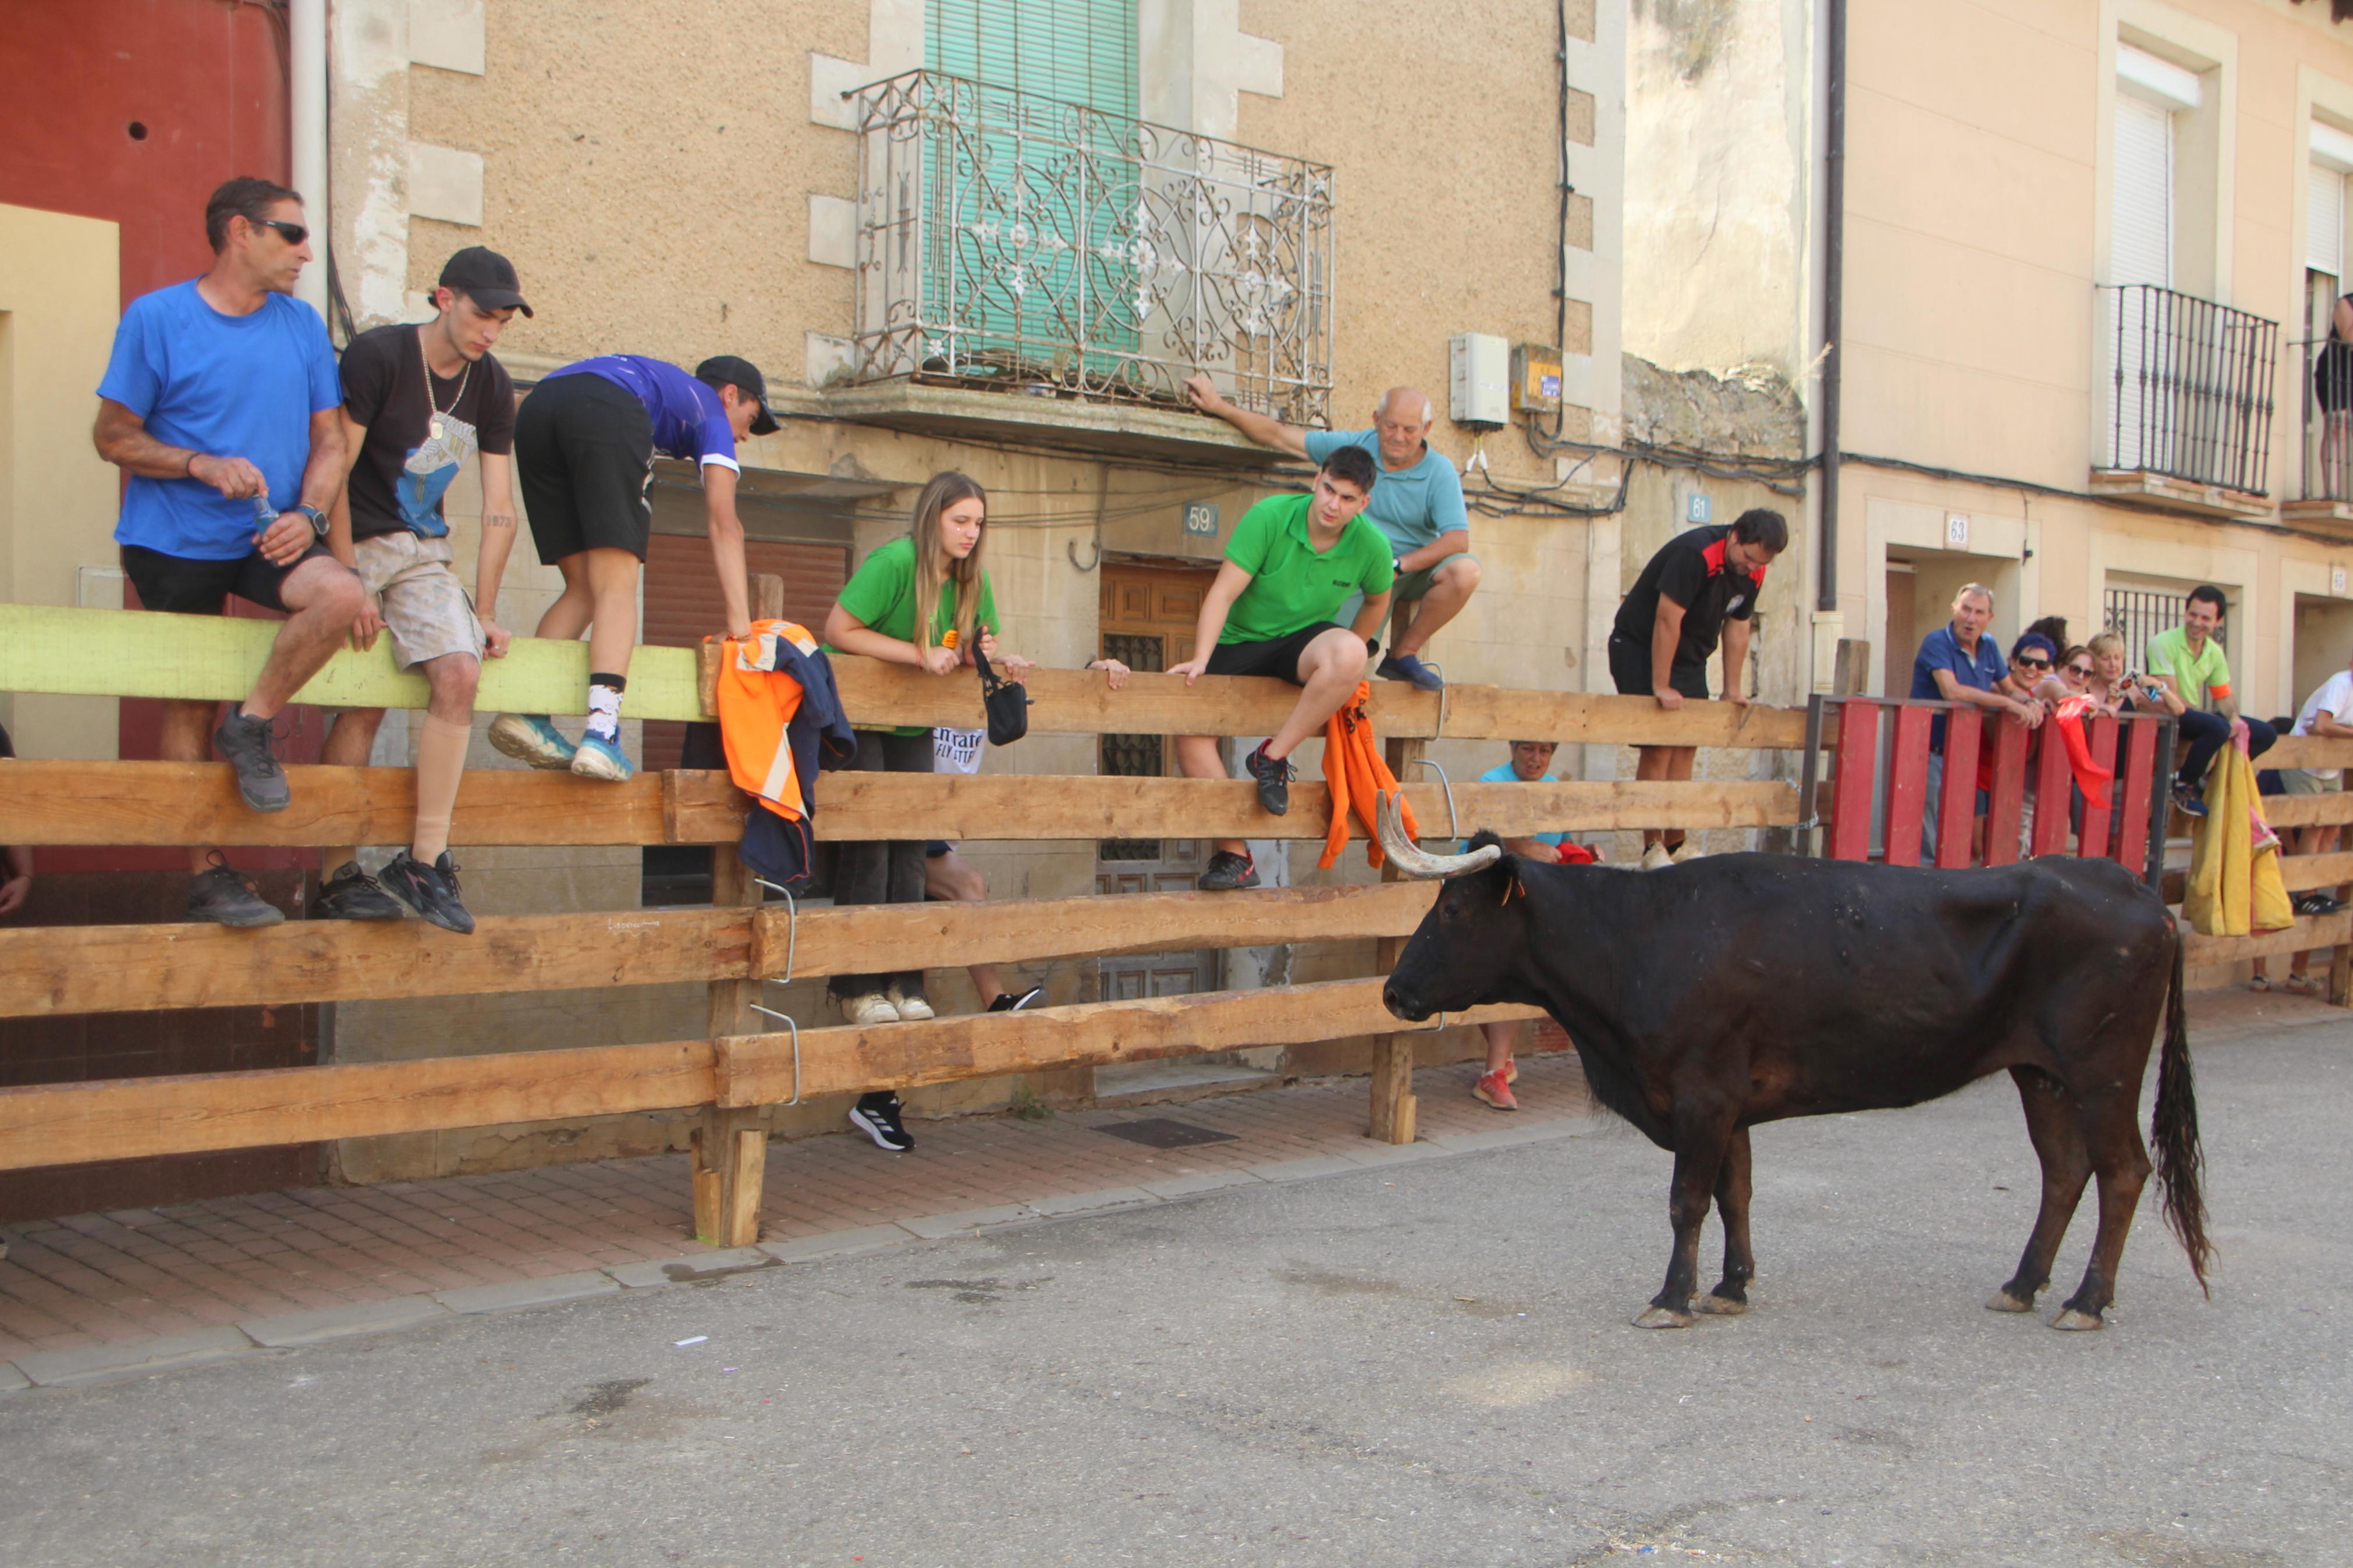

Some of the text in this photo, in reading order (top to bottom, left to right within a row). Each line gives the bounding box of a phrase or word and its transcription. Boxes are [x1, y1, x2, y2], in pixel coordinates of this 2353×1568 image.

[1692, 497, 1706, 518] 61
[1188, 506, 1210, 532] 59
[1950, 520, 1965, 542] 63
[935, 743, 953, 758] FLY
